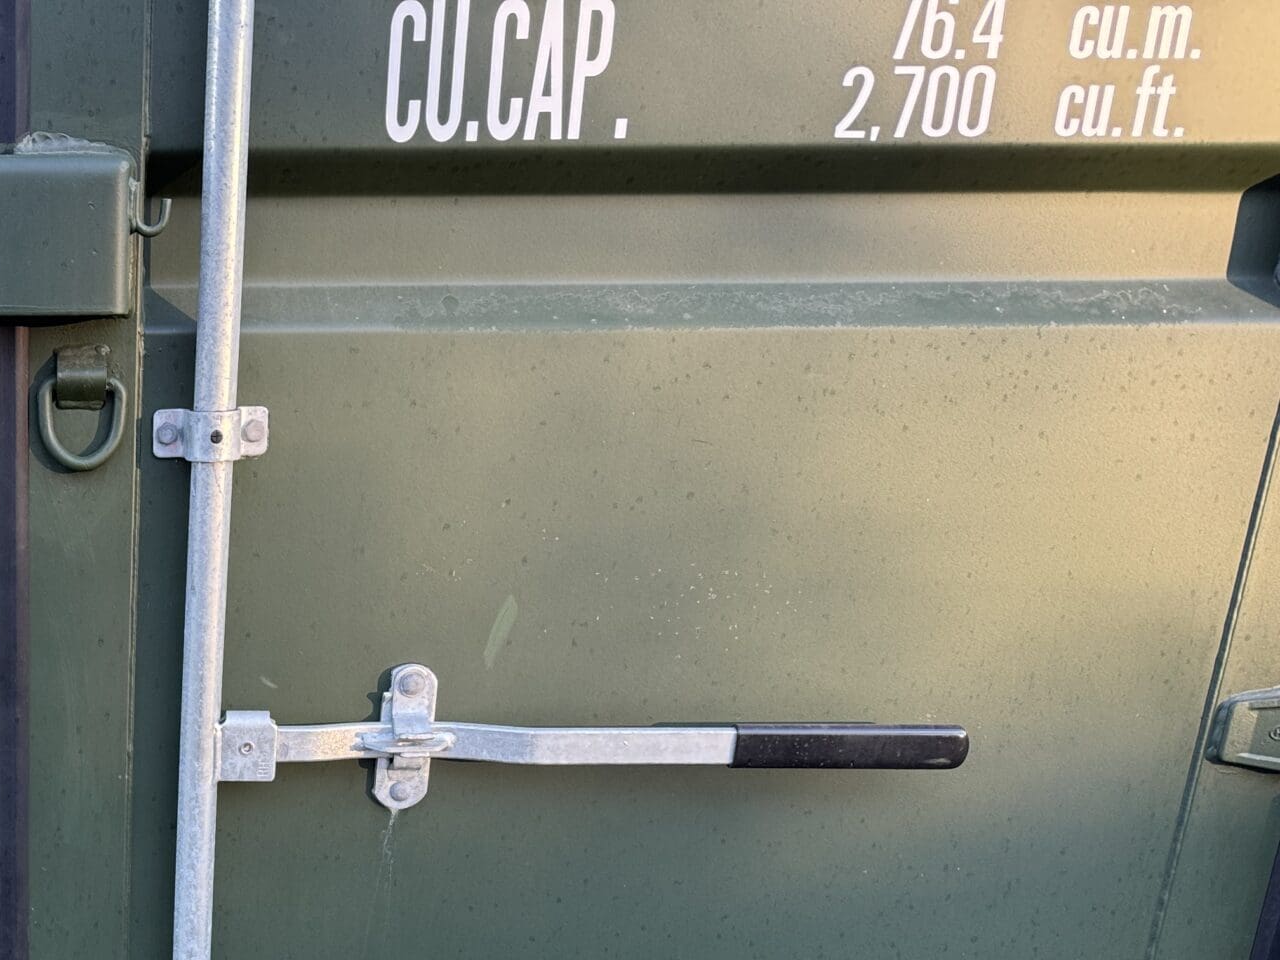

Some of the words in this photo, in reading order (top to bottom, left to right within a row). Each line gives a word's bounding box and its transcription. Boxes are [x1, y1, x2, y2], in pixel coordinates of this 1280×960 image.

[1068, 4, 1202, 60] cu.m.
[833, 64, 998, 142] 2,700
[1053, 64, 1186, 138] cu.ft.
